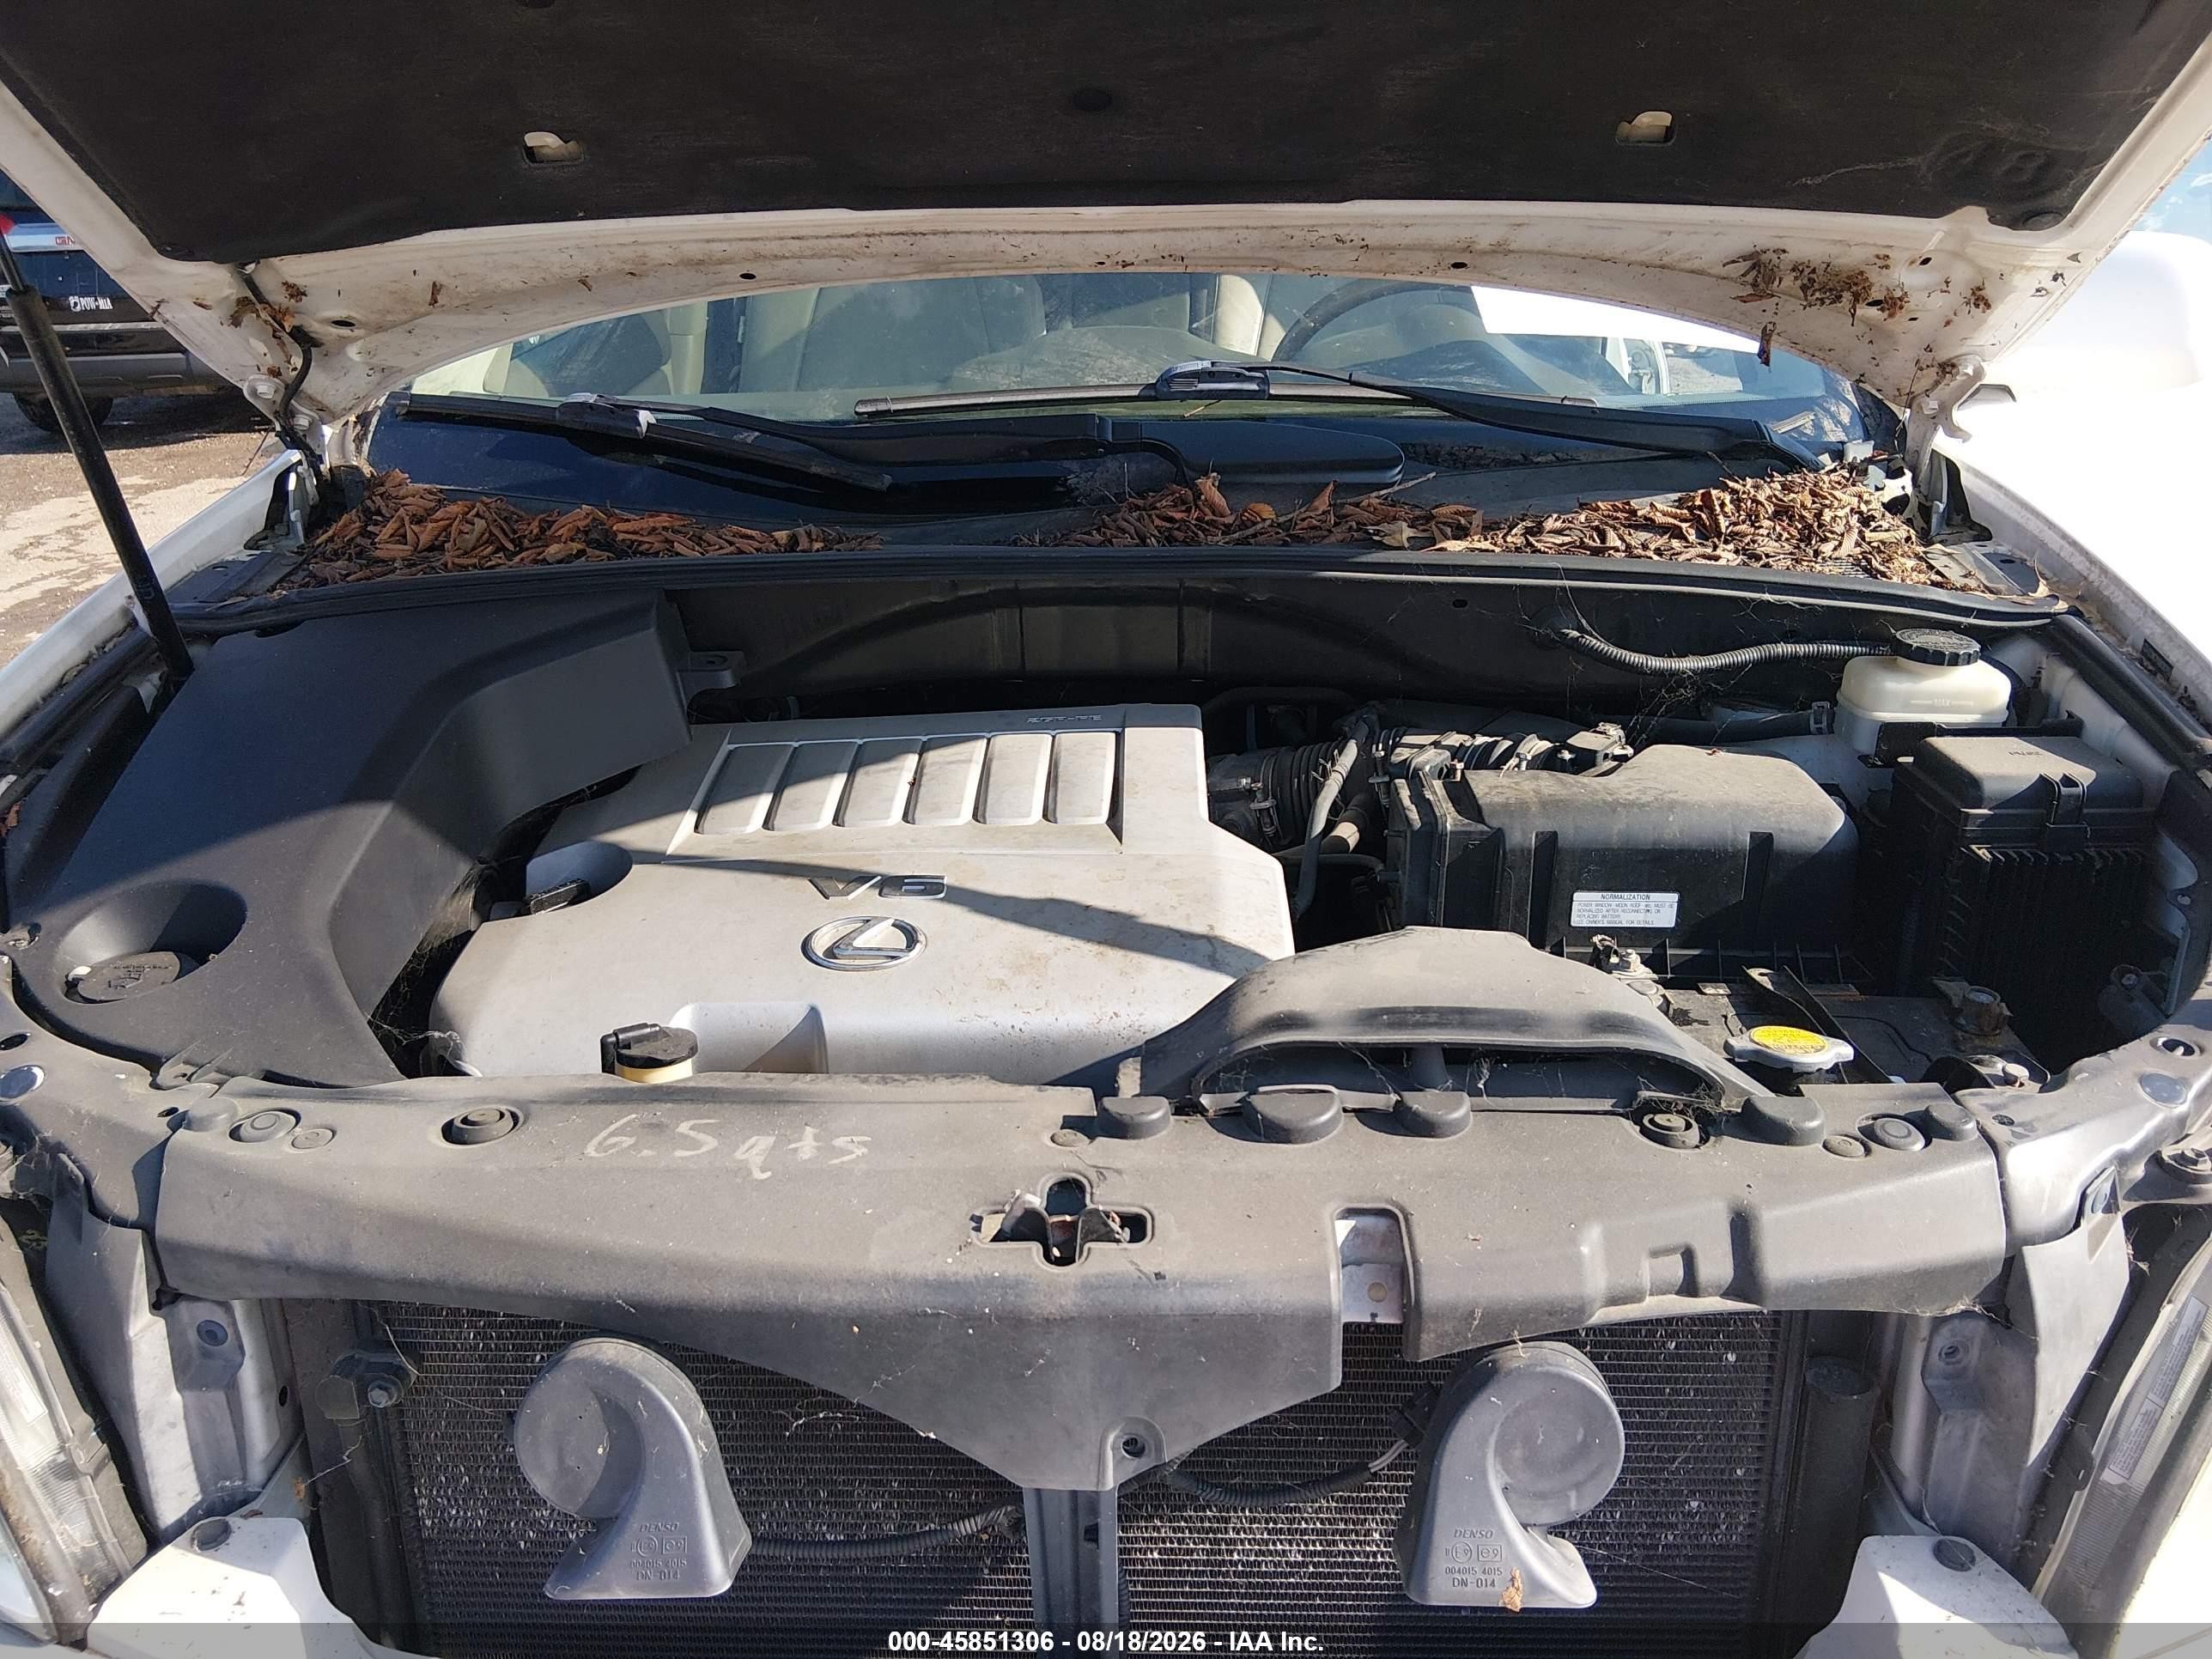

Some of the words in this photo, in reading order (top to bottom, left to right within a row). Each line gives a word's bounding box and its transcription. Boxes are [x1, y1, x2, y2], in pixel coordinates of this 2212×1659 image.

[807, 874, 948, 901] V6
[639, 1522, 679, 1533] DENSO
[1454, 1528, 1493, 1539] DENSO
[636, 1570, 680, 1581] DN-014
[1445, 1566, 1478, 1576] 004015
[1481, 1566, 1503, 1576] 4015
[1452, 1577, 1496, 1589] DN-014
